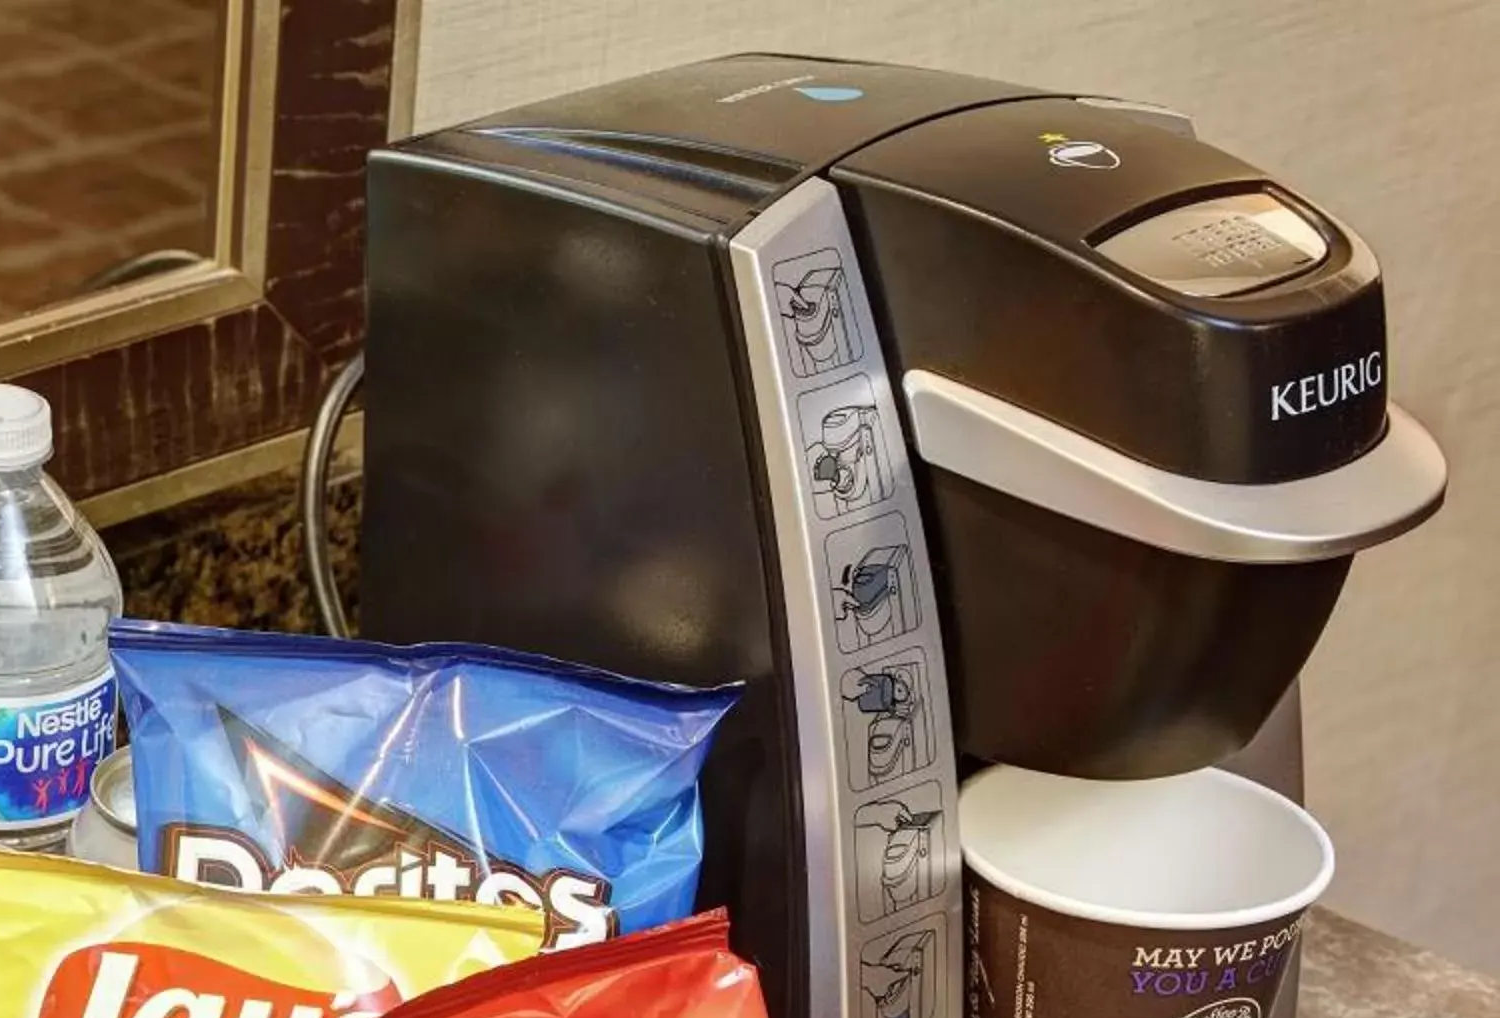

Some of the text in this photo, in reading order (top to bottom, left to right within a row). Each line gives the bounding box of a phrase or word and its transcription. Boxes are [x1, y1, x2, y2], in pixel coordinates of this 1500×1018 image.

[1269, 350, 1382, 421] KEURIG
[16, 694, 102, 740] Nestlé
[1131, 946, 1206, 969] MAY
[1213, 940, 1257, 966] WE
[1130, 970, 1206, 995] YOU
[1216, 966, 1238, 992] A
